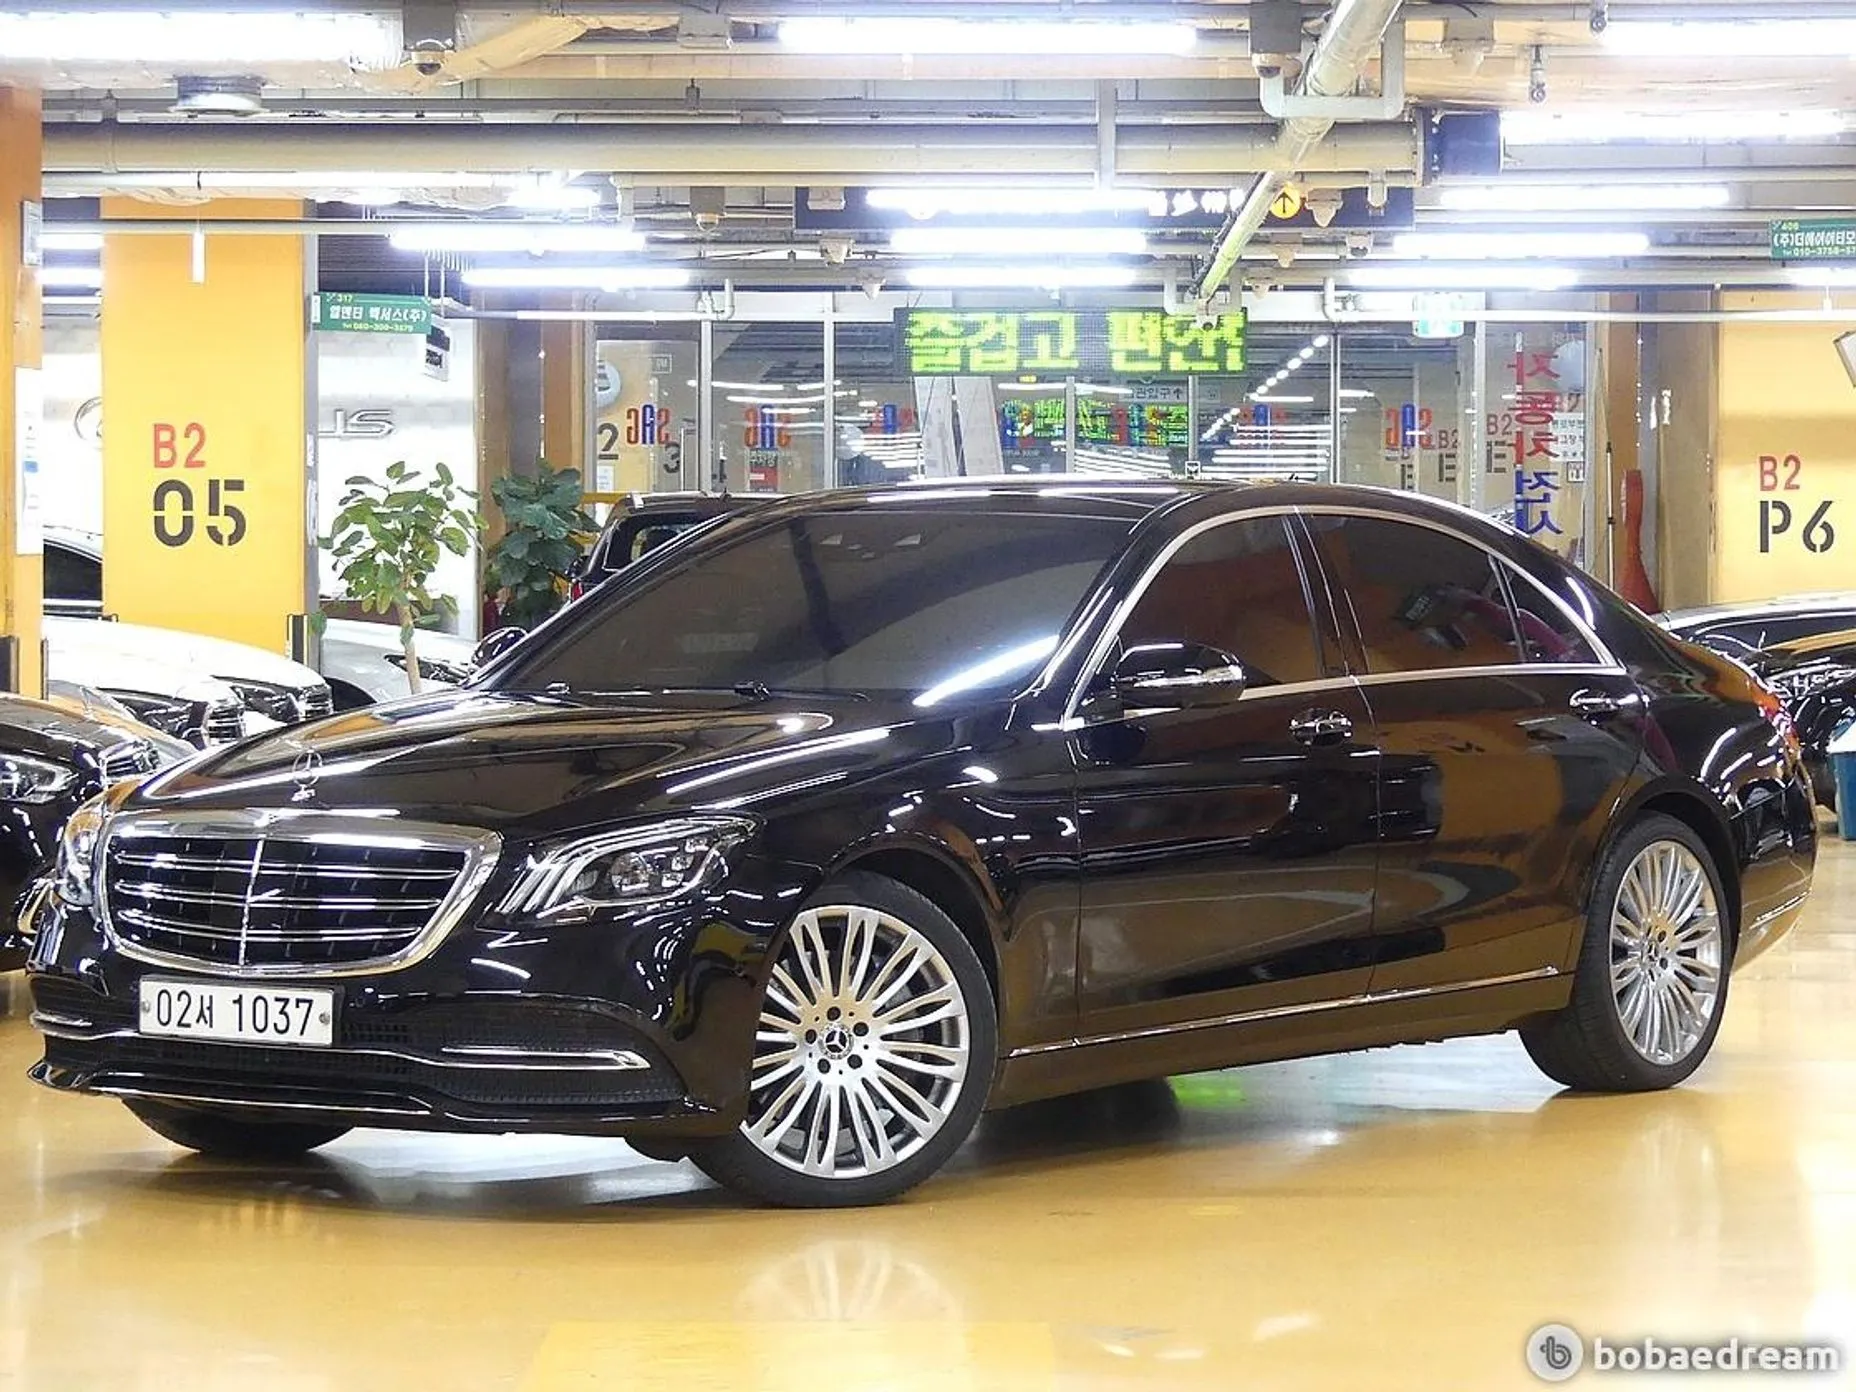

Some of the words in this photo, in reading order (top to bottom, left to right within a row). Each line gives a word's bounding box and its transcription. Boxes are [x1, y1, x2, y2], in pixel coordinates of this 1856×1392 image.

[154, 422, 206, 468] B2
[1486, 413, 1513, 436] B2
[1759, 454, 1801, 491] B2
[153, 479, 247, 547] 05
[1759, 500, 1835, 553] P6
[157, 989, 214, 1028] 02서
[232, 994, 314, 1037] 1037
